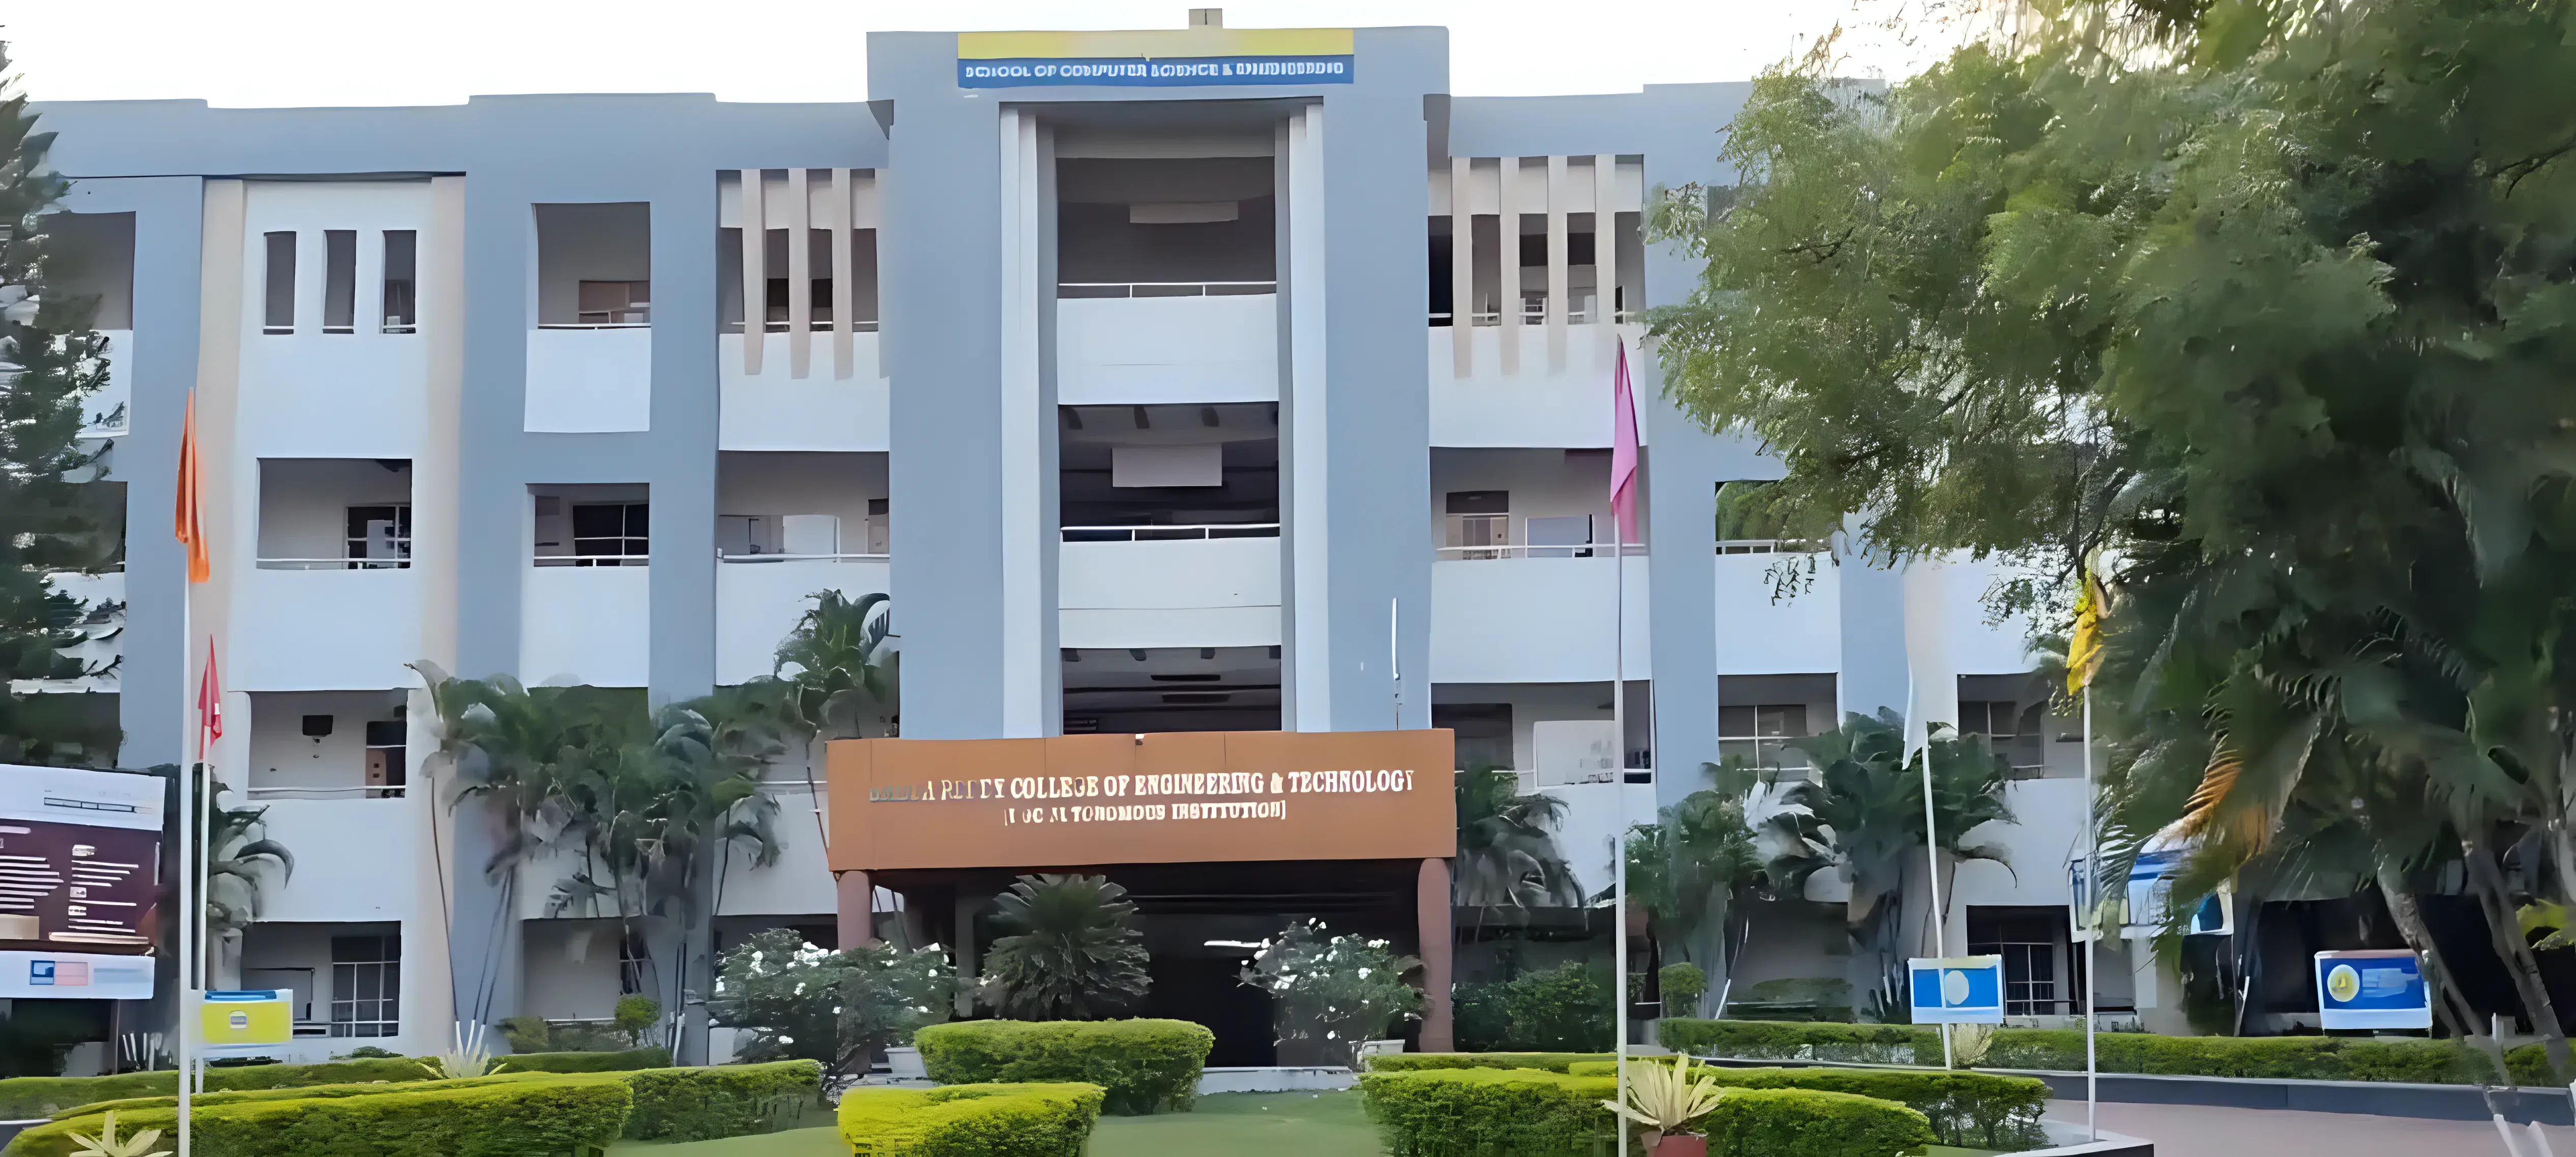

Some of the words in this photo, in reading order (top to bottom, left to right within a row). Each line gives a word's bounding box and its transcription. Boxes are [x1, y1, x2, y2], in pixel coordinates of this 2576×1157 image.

[1010, 776, 1099, 799] COLLEGE
[1103, 775, 1130, 797] OF
[1134, 772, 1264, 796] ENGINEERING
[1287, 770, 1415, 793] TECHNOLOGY
